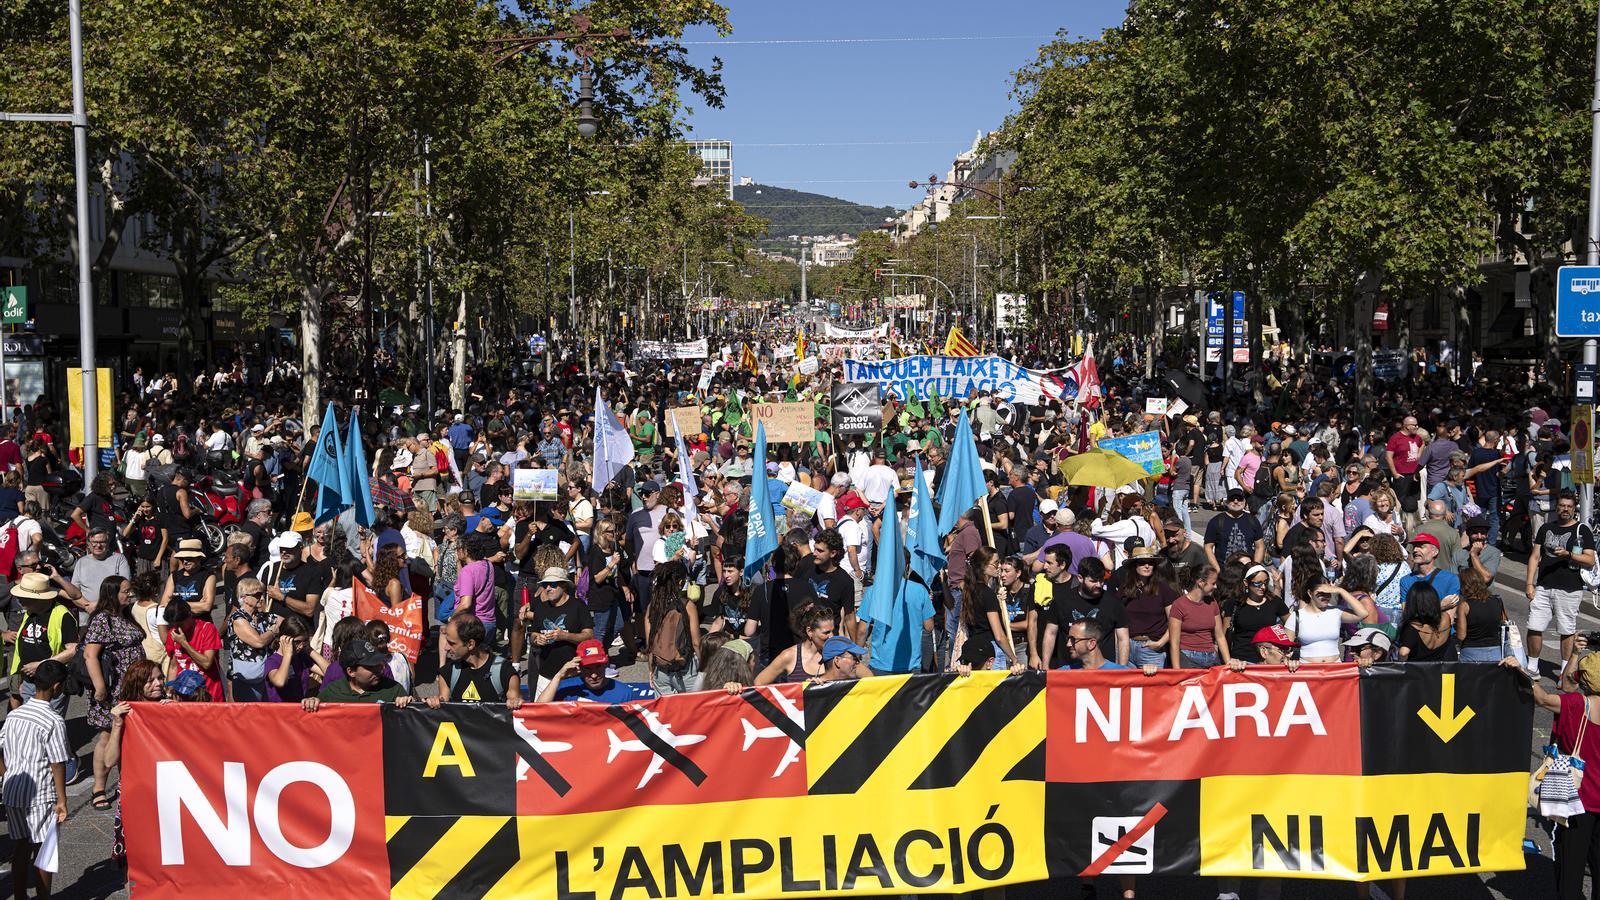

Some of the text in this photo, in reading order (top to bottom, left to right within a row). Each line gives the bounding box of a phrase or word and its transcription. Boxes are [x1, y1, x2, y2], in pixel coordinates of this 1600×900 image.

[4, 307, 24, 318] adif
[845, 356, 932, 380] TANQUEM
[757, 405, 773, 418] NO
[843, 415, 869, 423] PROU
[838, 422, 875, 430] SOROLL
[751, 512, 766, 538] PAM
[1074, 681, 1328, 743] NI ARA
[156, 721, 476, 869] NO A
[555, 803, 1015, 900] L'AMPLIACIÓ
[1251, 812, 1481, 873] NI MAI
